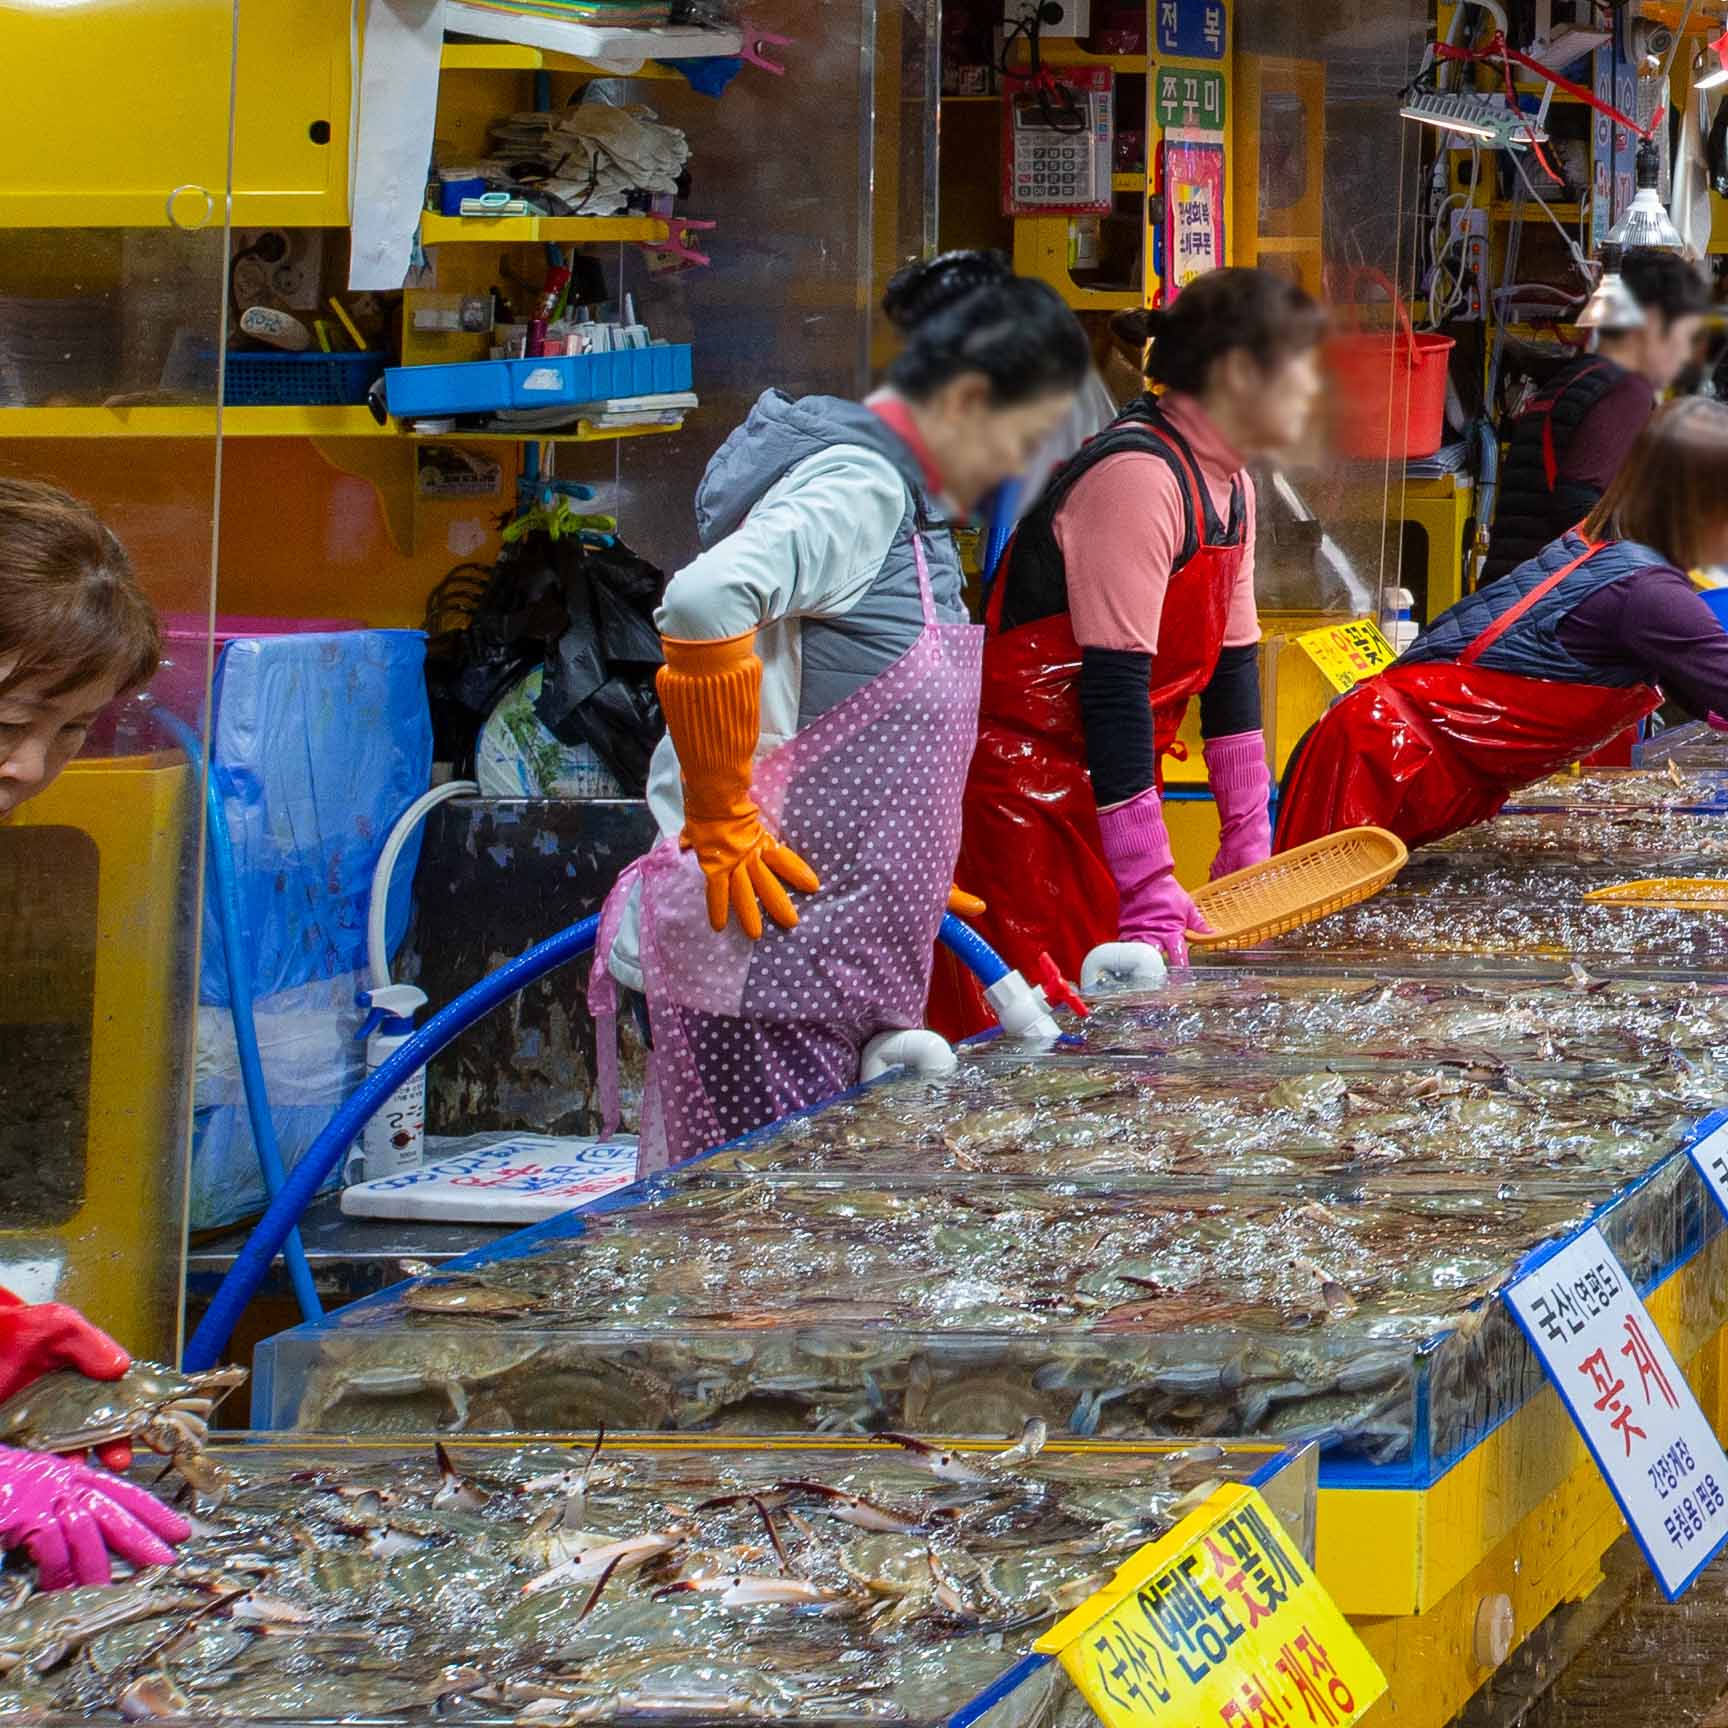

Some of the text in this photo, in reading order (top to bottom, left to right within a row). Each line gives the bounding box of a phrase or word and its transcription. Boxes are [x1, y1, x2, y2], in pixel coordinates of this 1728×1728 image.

[1162, 76, 1219, 123] 쭈꾸미
[1579, 1314, 1679, 1457] 꽃게
[1648, 1437, 1695, 1498] 간장게장
[1664, 1474, 1724, 1550] 무침용/찜용
